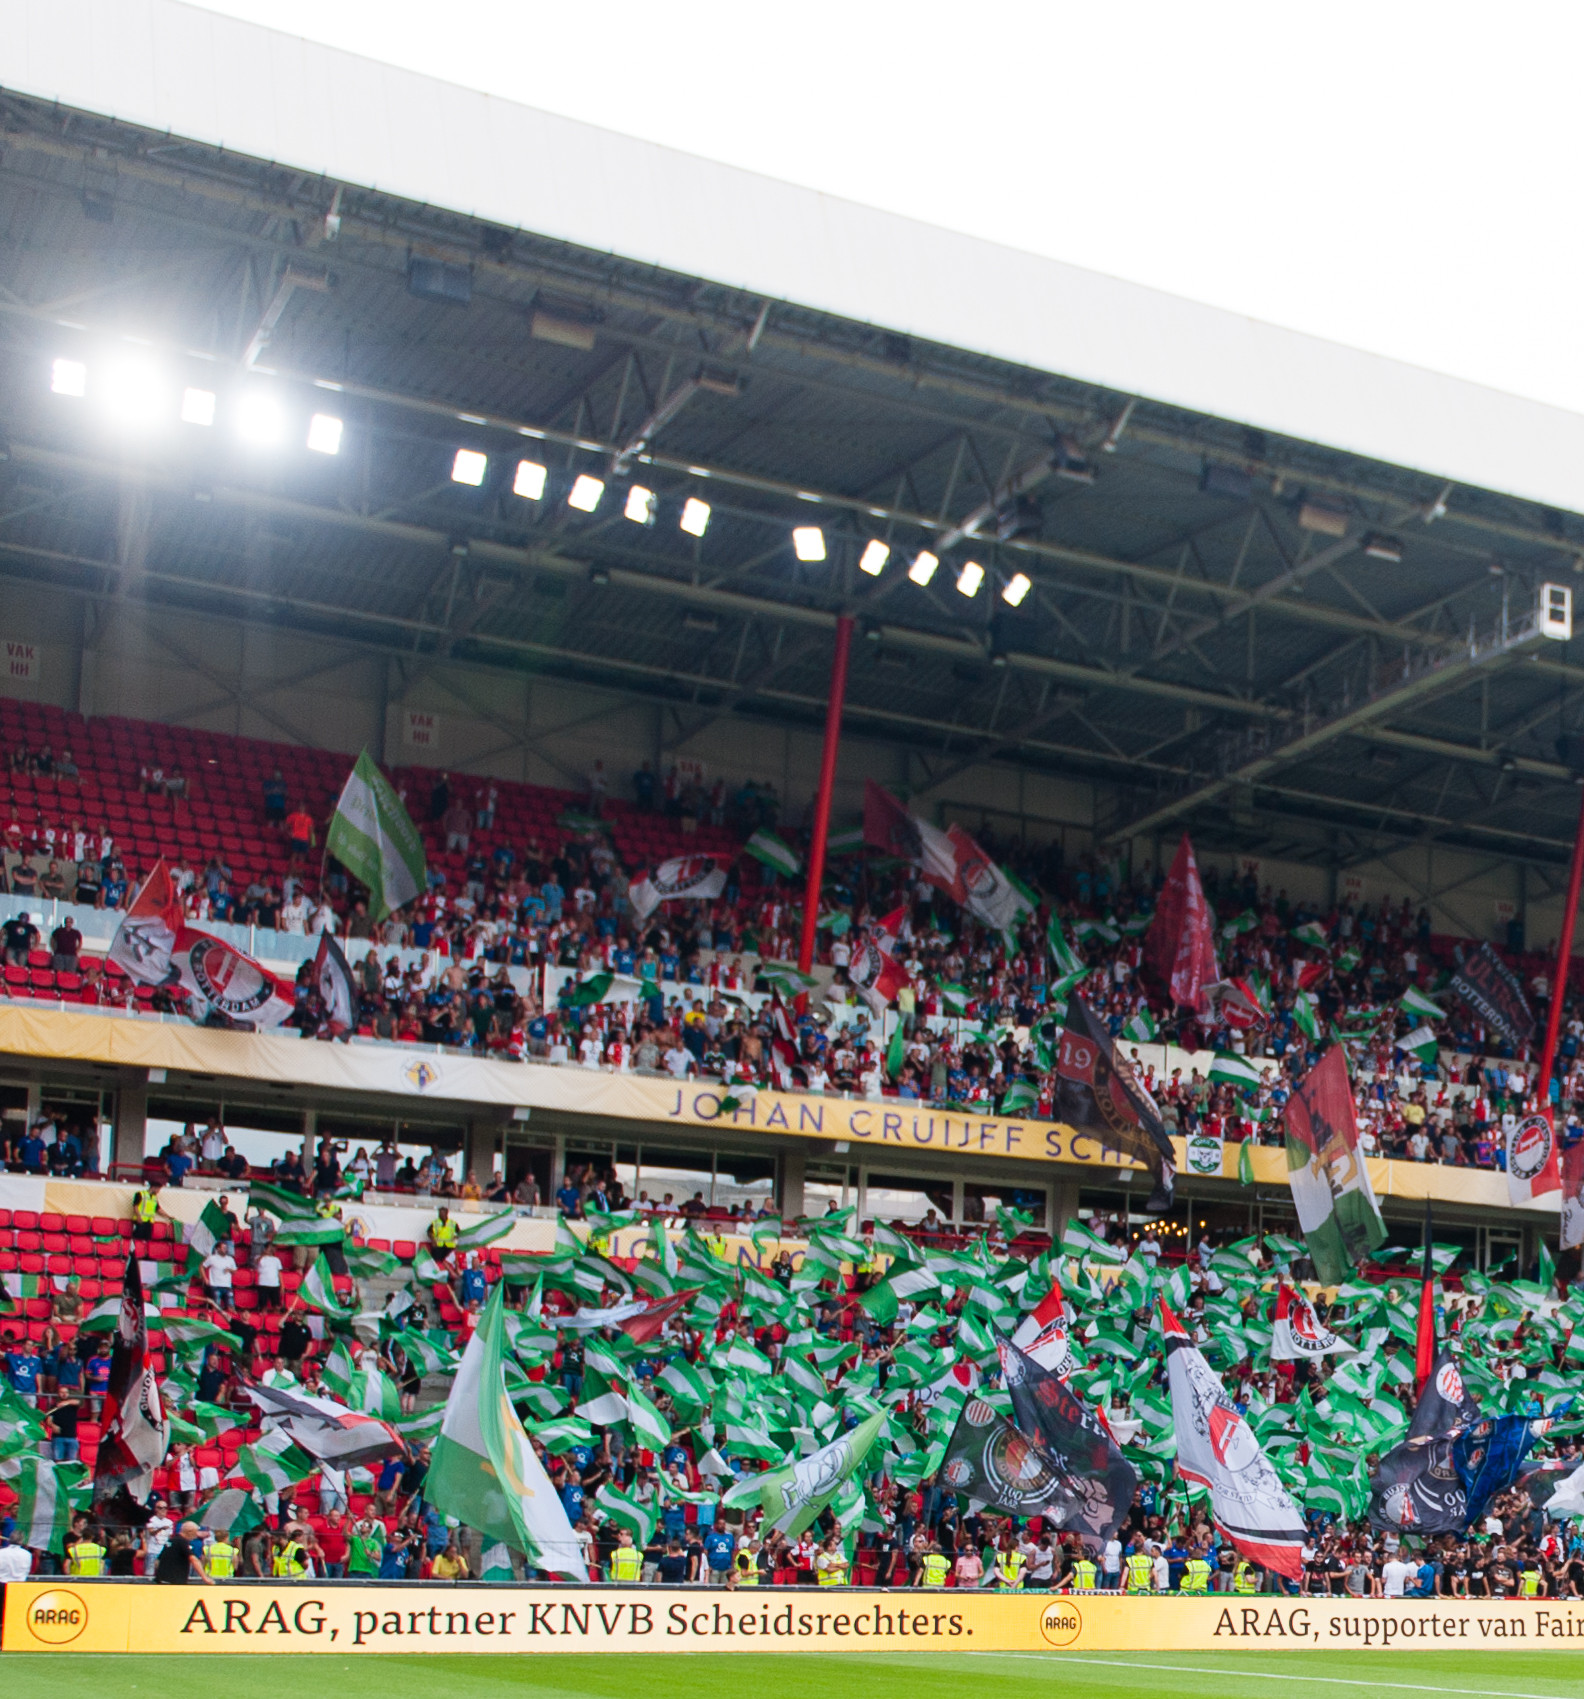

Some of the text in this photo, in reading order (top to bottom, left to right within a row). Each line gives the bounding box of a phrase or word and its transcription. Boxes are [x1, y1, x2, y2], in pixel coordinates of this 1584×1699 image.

[7, 643, 34, 659] VAK
[410, 713, 433, 727] VAK
[1064, 1042, 1092, 1070] 19
[849, 1110, 1022, 1152] CRUIJFF
[34, 1609, 80, 1625] ARAG
[180, 1598, 974, 1645] ARAG, partner KNVB Scheidsrechters.
[1045, 1617, 1077, 1630] ARAG
[1213, 1608, 1319, 1642] ARAG,
[1329, 1612, 1470, 1645] supporter
[1477, 1616, 1526, 1637] van
